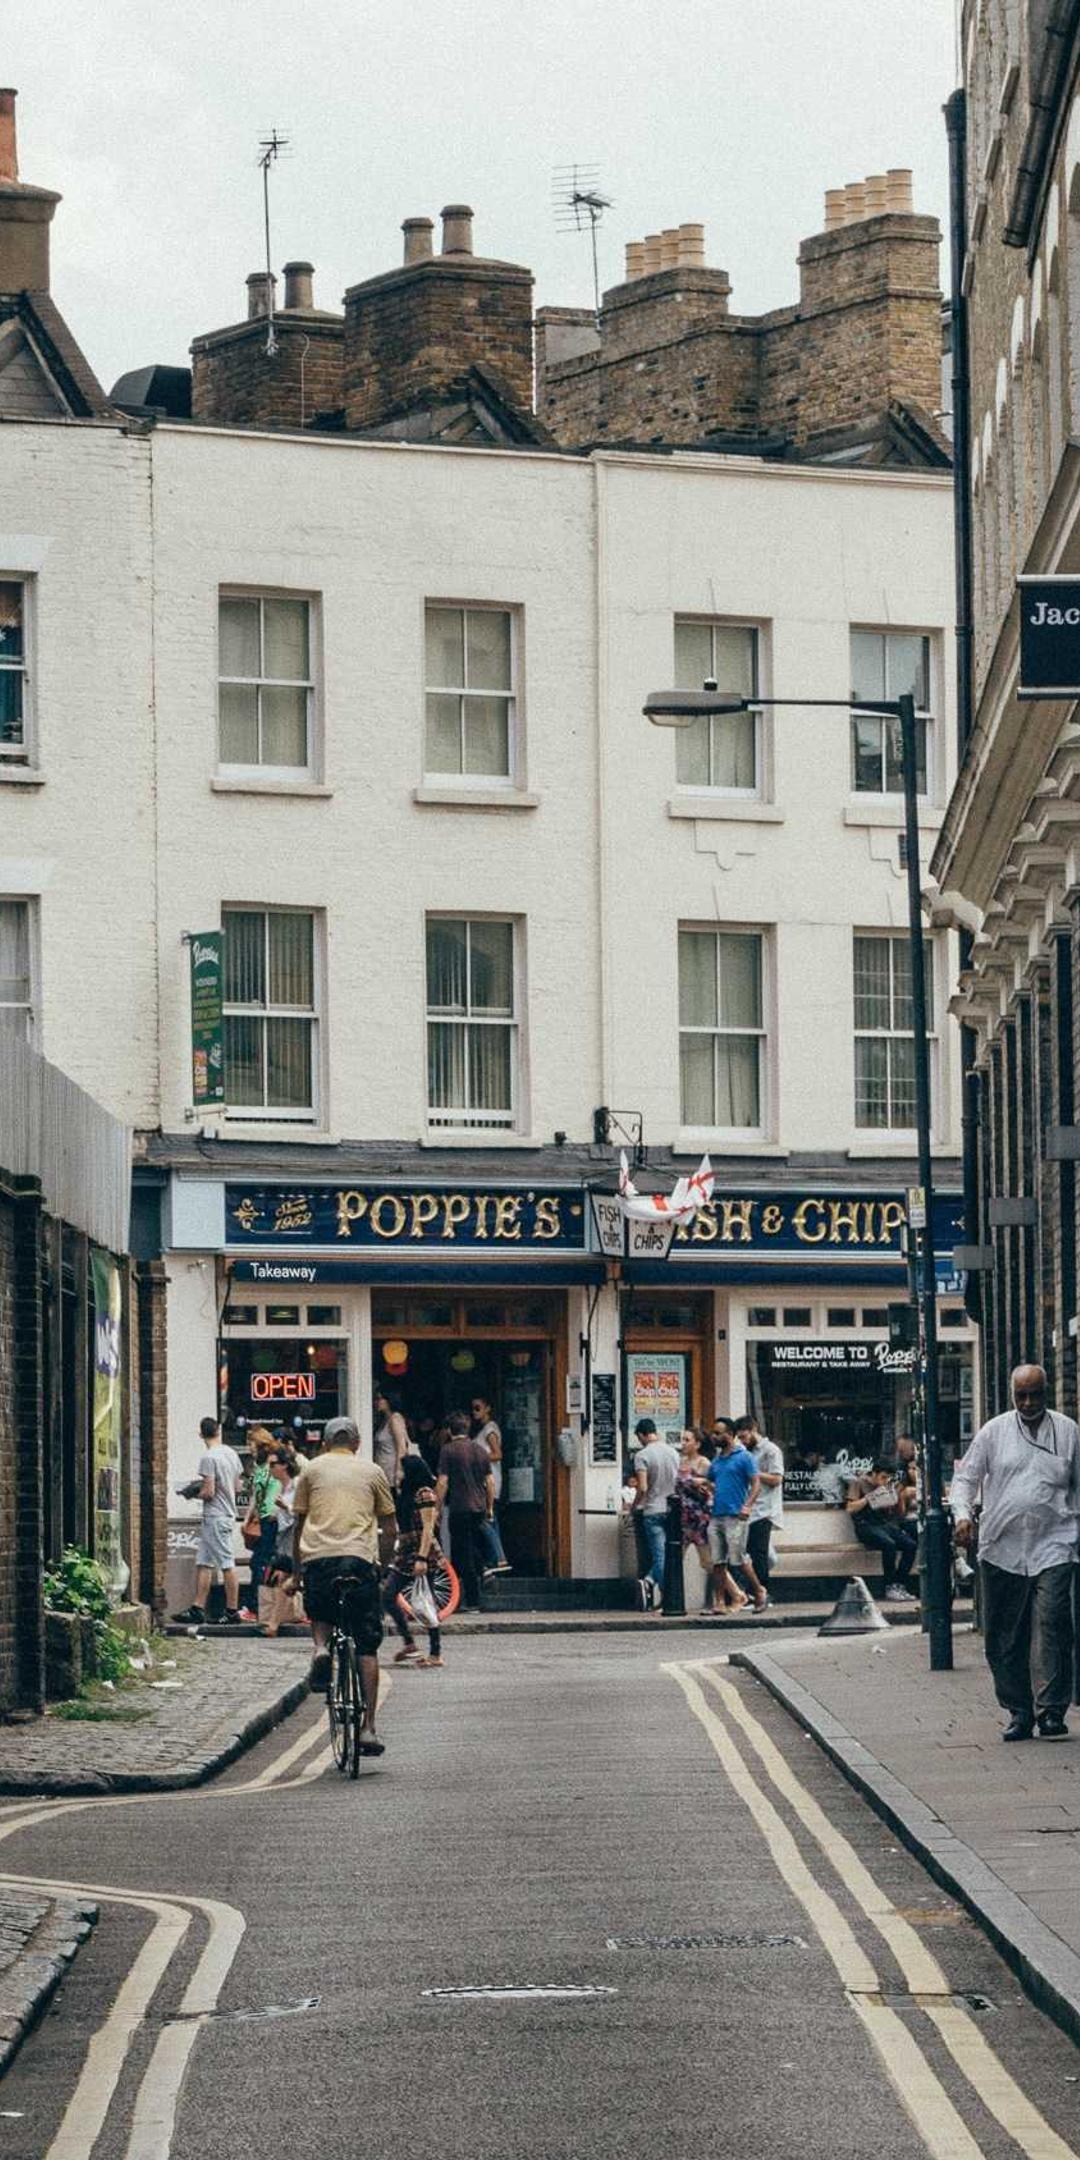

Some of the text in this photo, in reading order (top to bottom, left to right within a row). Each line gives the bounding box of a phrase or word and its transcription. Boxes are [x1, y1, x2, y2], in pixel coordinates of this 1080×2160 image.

[273, 1211, 313, 1232] 1952
[336, 1190, 562, 1239] POPPIE'S
[598, 1203, 621, 1225] FISH
[762, 1204, 784, 1234] &
[791, 1199, 908, 1243] CHIP
[602, 1231, 622, 1249] CHIPS
[633, 1233, 666, 1251] CHIPS
[250, 1262, 316, 1282] Takeaway
[774, 1347, 868, 1359] WELCOME TO
[254, 1375, 313, 1398] OPEN
